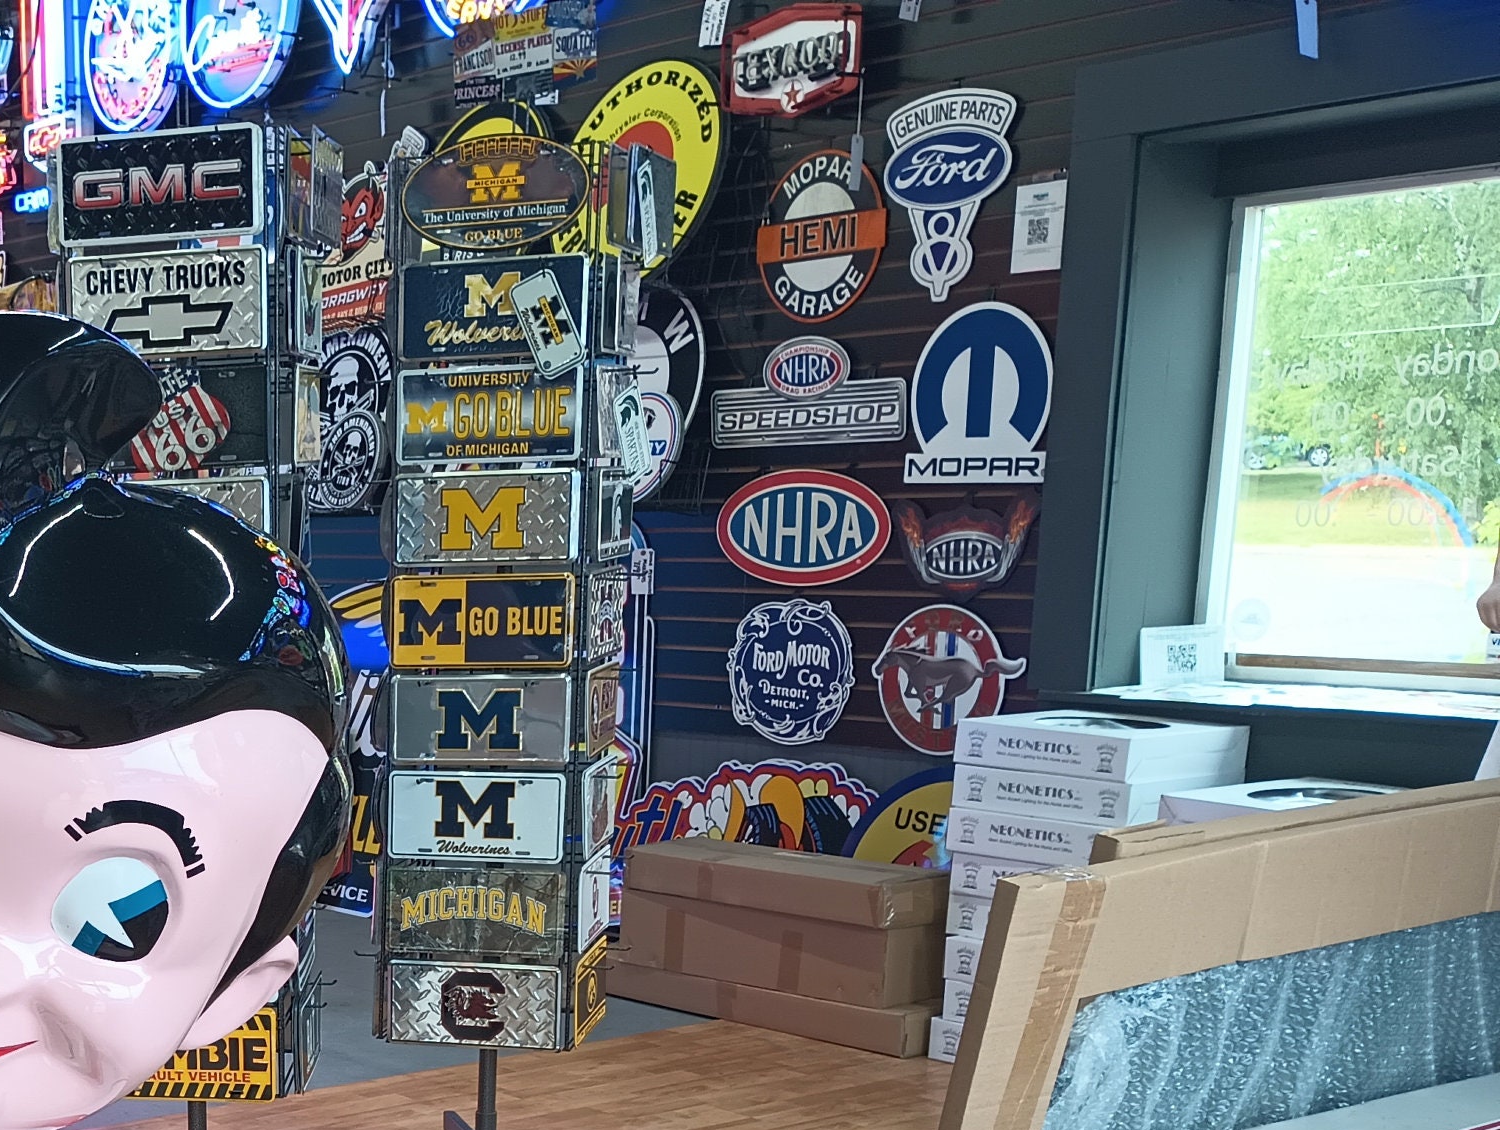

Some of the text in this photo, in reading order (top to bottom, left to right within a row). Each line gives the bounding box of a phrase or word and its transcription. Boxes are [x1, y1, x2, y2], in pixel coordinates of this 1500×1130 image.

[496, 33, 553, 55] LICENSE PLATES
[556, 29, 596, 53] SQUATCH
[895, 101, 1005, 138] GENUINE PARTS
[895, 143, 997, 190] Ford
[71, 158, 243, 210] GMC
[474, 178, 519, 187] MICHIGAN
[423, 202, 567, 224] The University of Michigan
[780, 213, 857, 257] HEMI
[85, 260, 246, 296] CHEVY TRUCKS
[774, 265, 865, 316] GARAGE
[779, 344, 831, 363] CHAMPIONSHIP
[448, 372, 530, 388] UNIVERSITY
[779, 356, 831, 385] NHRA
[782, 380, 830, 395] DRAG RACING
[406, 387, 573, 440] M GO BLUE
[720, 402, 896, 431] SPEEDSHOP
[155, 412, 215, 472] 66
[446, 441, 530, 457] OF MICHIGAN
[907, 456, 1041, 478] MOPAR
[440, 486, 526, 551] M
[743, 490, 864, 564] NHRA
[932, 543, 998, 571] NHRA
[399, 598, 563, 646] M GO BLUE
[752, 640, 831, 680] FORD MOTOR
[435, 688, 524, 752] M
[998, 737, 1072, 756] NEONETICS
[998, 781, 1074, 800] NEONETICS
[434, 780, 516, 839] M
[894, 807, 946, 836] USE
[436, 839, 511, 856] Wolverines
[989, 823, 1064, 844] NEONETICS
[400, 886, 547, 937] MICHIGAN
[189, 1071, 251, 1083] VEHICLE
